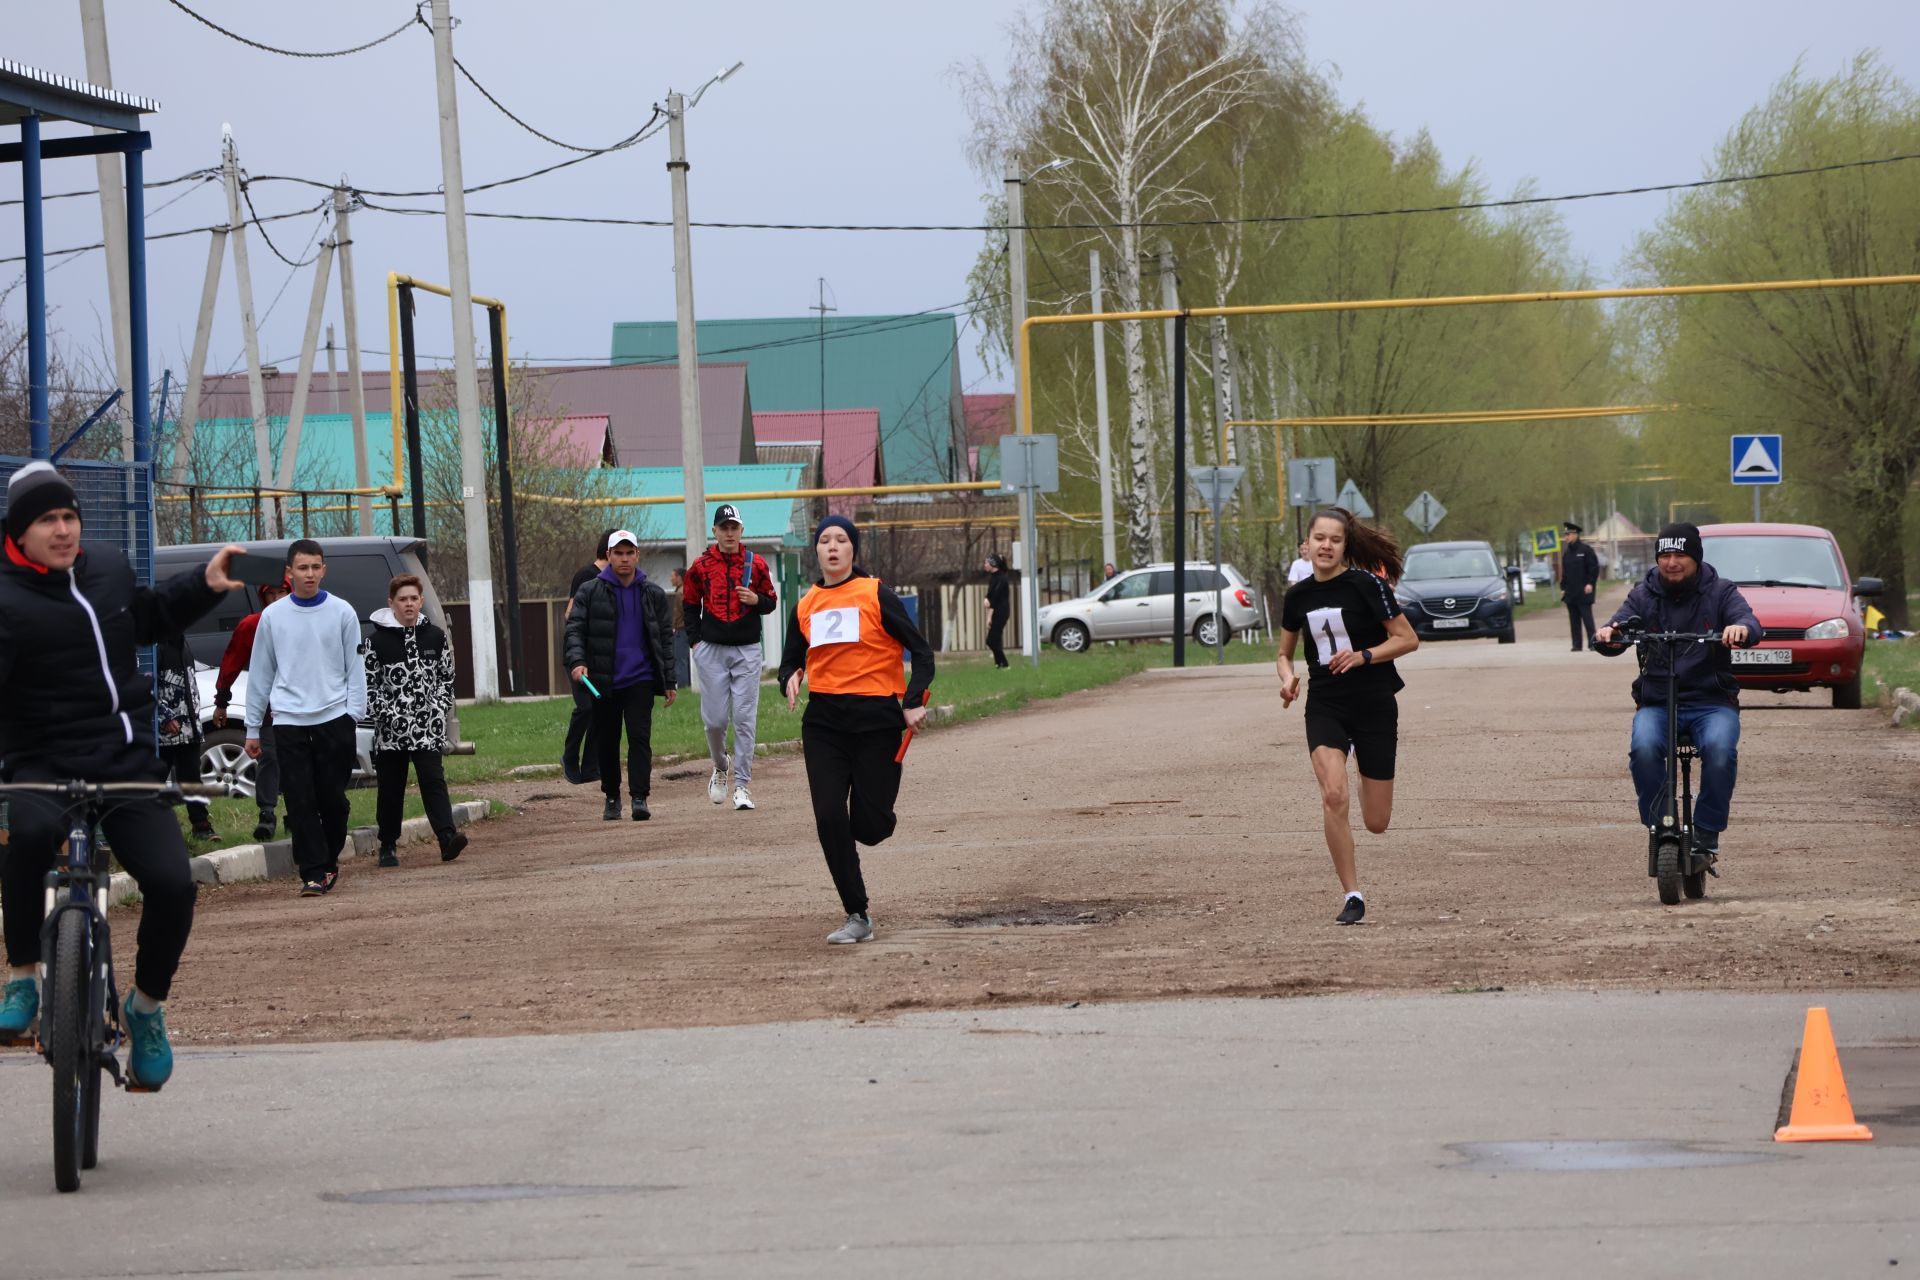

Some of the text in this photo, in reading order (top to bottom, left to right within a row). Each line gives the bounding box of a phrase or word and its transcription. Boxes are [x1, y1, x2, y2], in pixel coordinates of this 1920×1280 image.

[825, 611, 842, 639] 2
[1322, 618, 1337, 656] 1
[1774, 650, 1790, 660] 102
